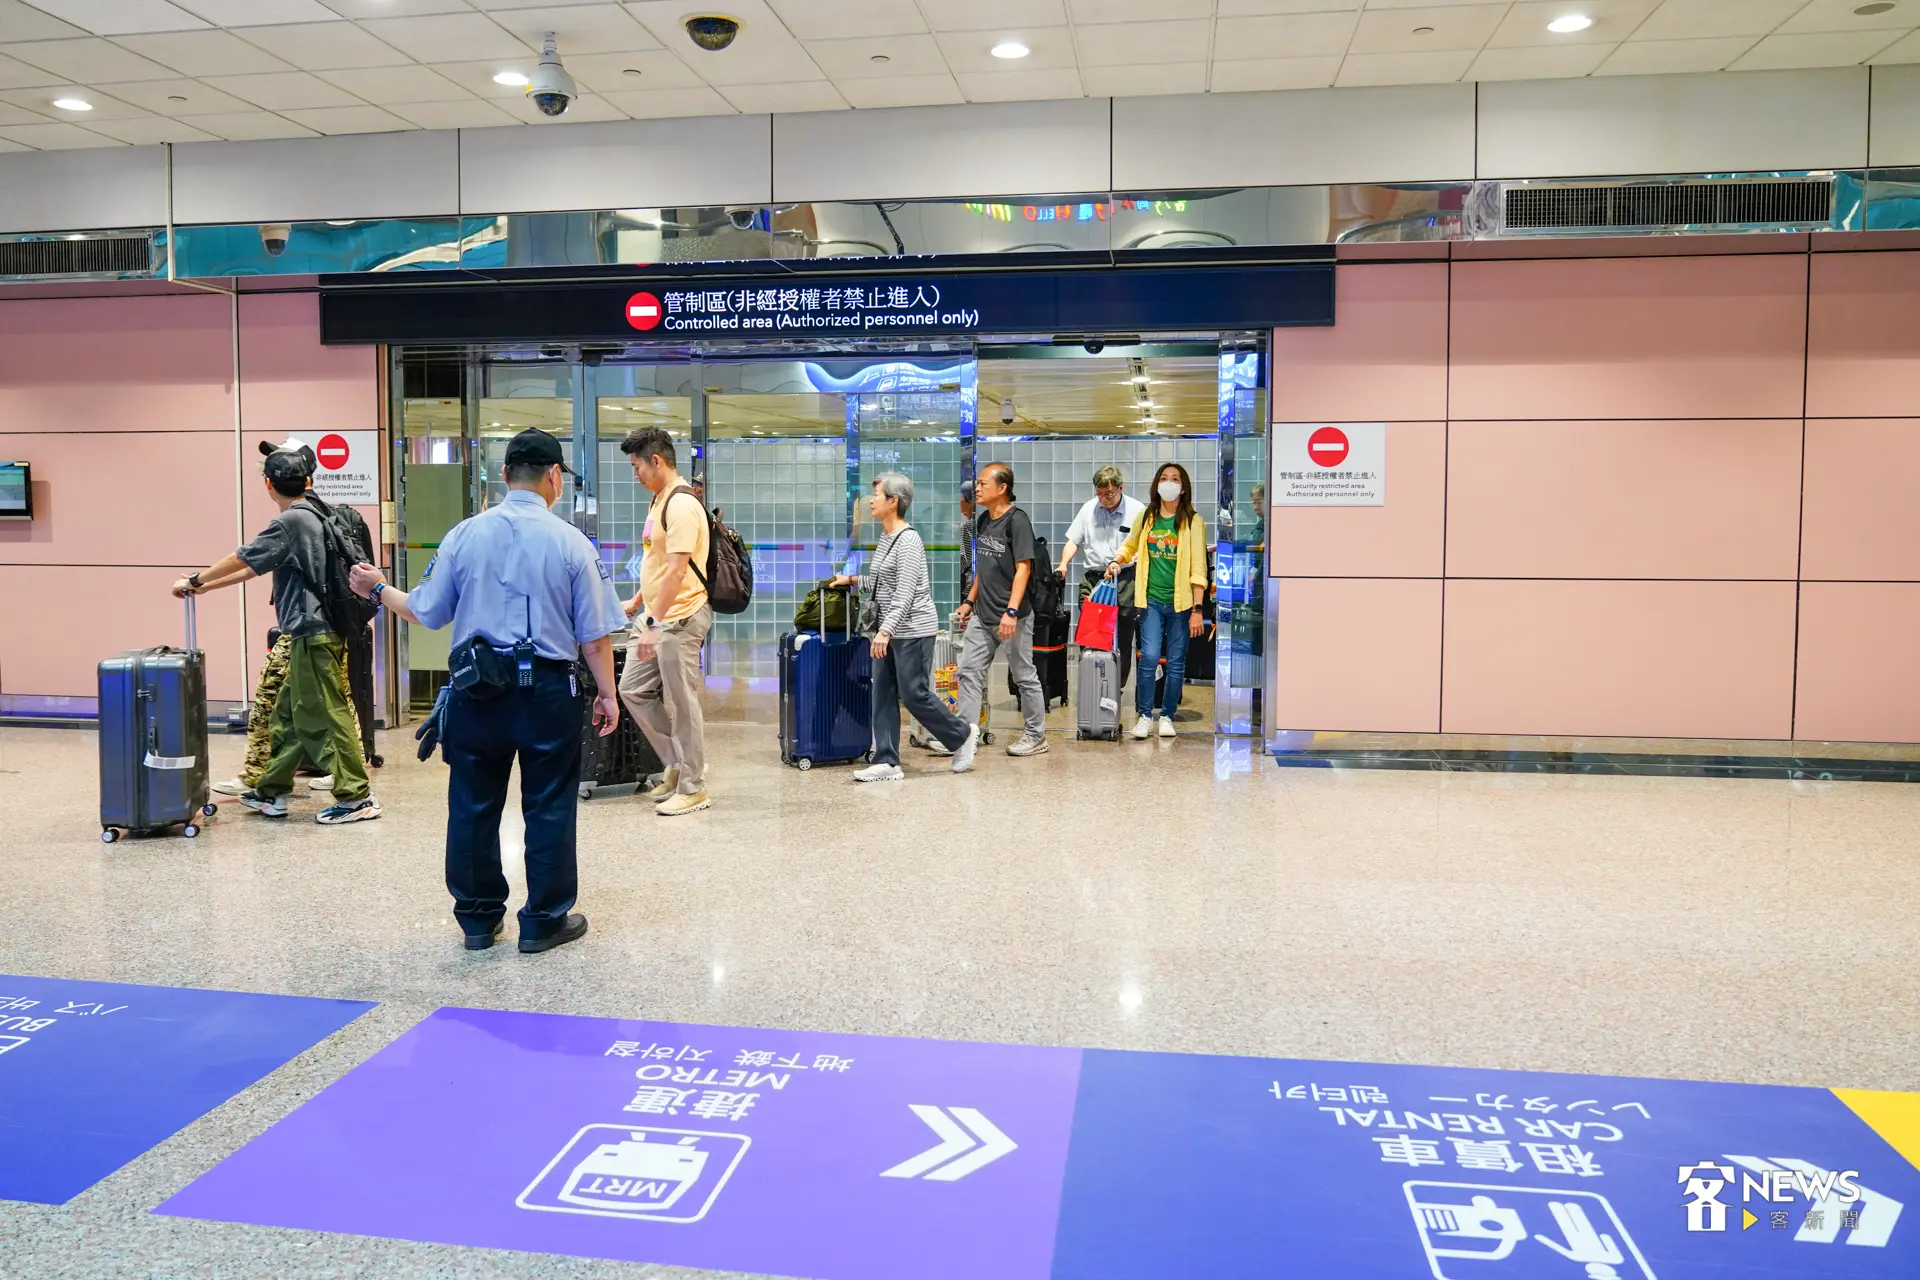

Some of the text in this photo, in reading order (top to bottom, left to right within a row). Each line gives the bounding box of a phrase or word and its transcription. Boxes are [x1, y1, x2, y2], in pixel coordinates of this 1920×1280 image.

[663, 285, 940, 316] 管制區(非經授權者禁止進入)
[664, 308, 979, 331] Controlled area (Authorized personnel only)
[1291, 482, 1317, 490] Security
[1324, 490, 1359, 498] personnel
[1359, 490, 1375, 498] only
[53, 1001, 129, 1016] バス
[604, 1040, 713, 1062] 지하철
[635, 1064, 791, 1090] METRO
[622, 1085, 761, 1121] 捷運
[1268, 1080, 1652, 1119] レンタカー 렌터카
[1318, 1106, 1624, 1142] CAR RENTAL
[1371, 1133, 1605, 1177] 租賃車
[578, 1176, 669, 1199] MRT
